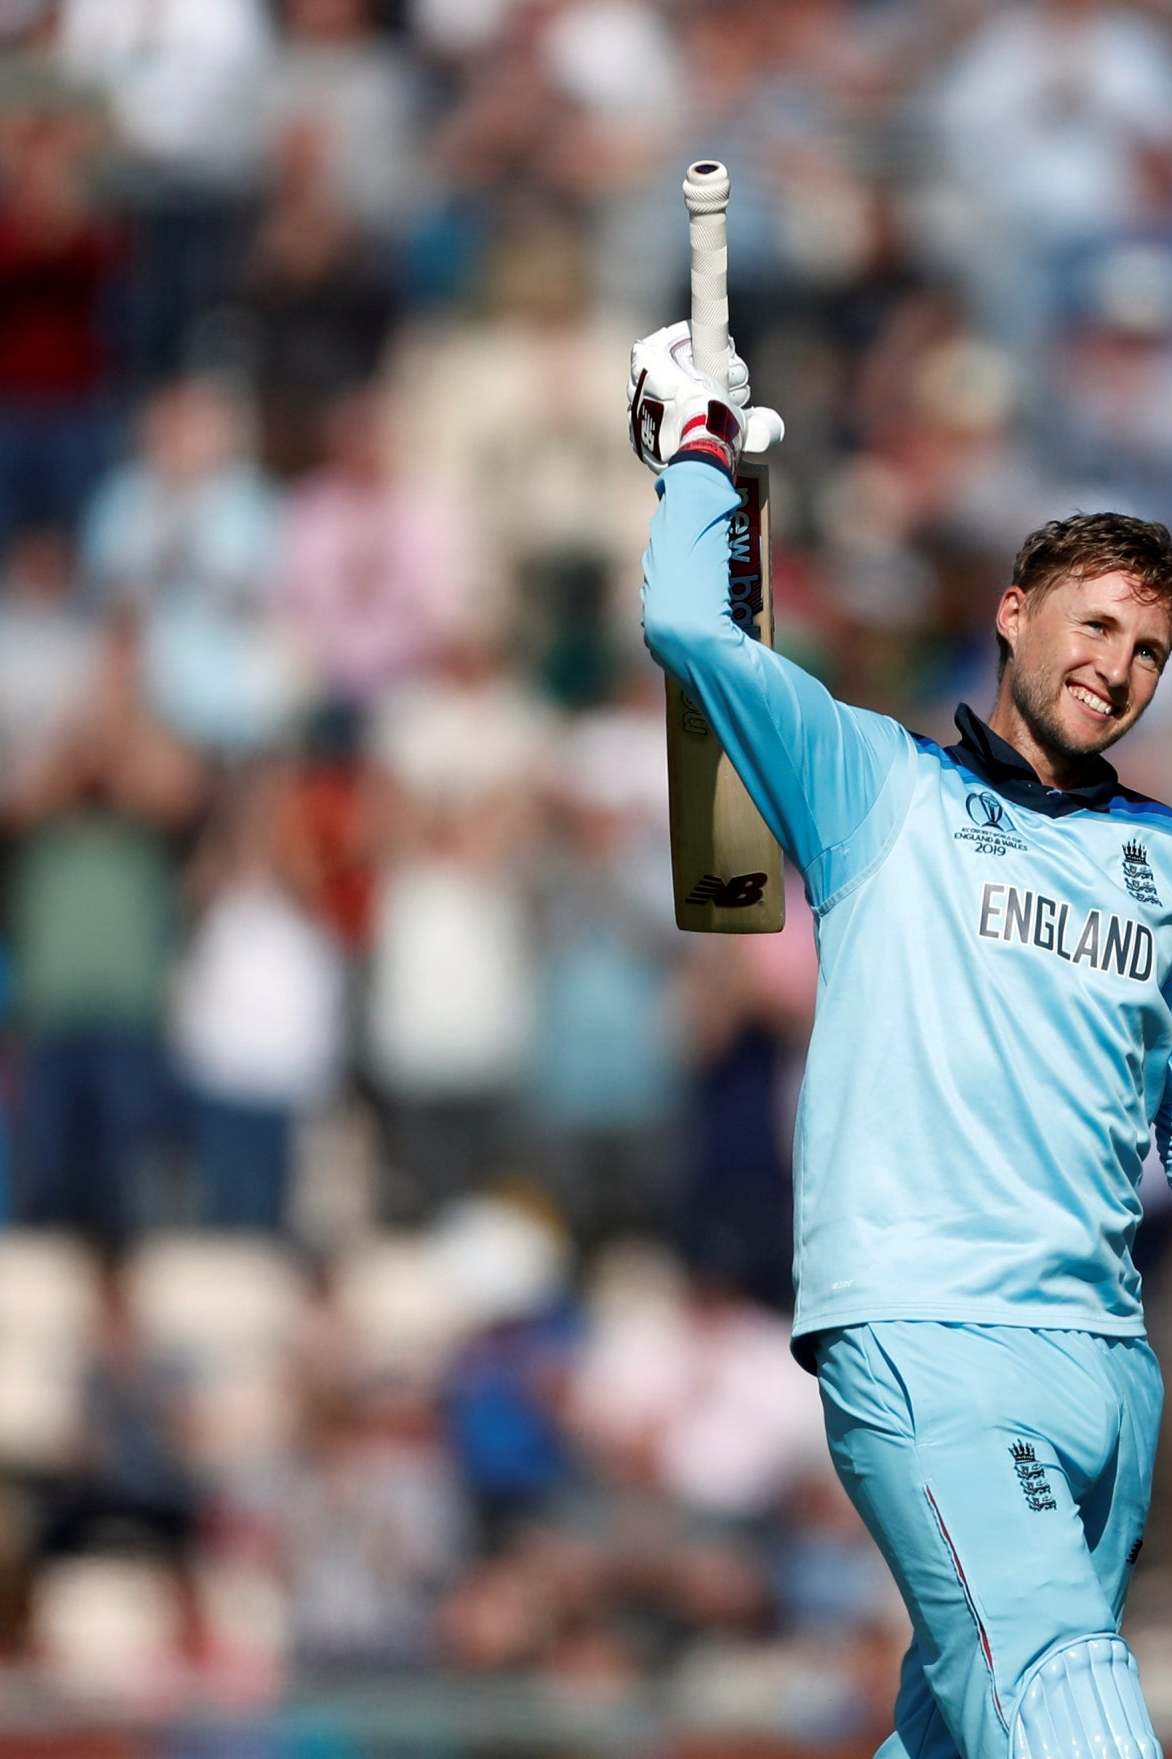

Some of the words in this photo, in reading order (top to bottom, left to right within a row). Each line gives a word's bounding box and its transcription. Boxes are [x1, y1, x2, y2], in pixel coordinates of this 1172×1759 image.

[954, 831, 993, 843] ENGLAND
[1001, 839, 1028, 851] WALES
[975, 842, 1006, 856] 2019
[978, 882, 1153, 982] ENGLAND
